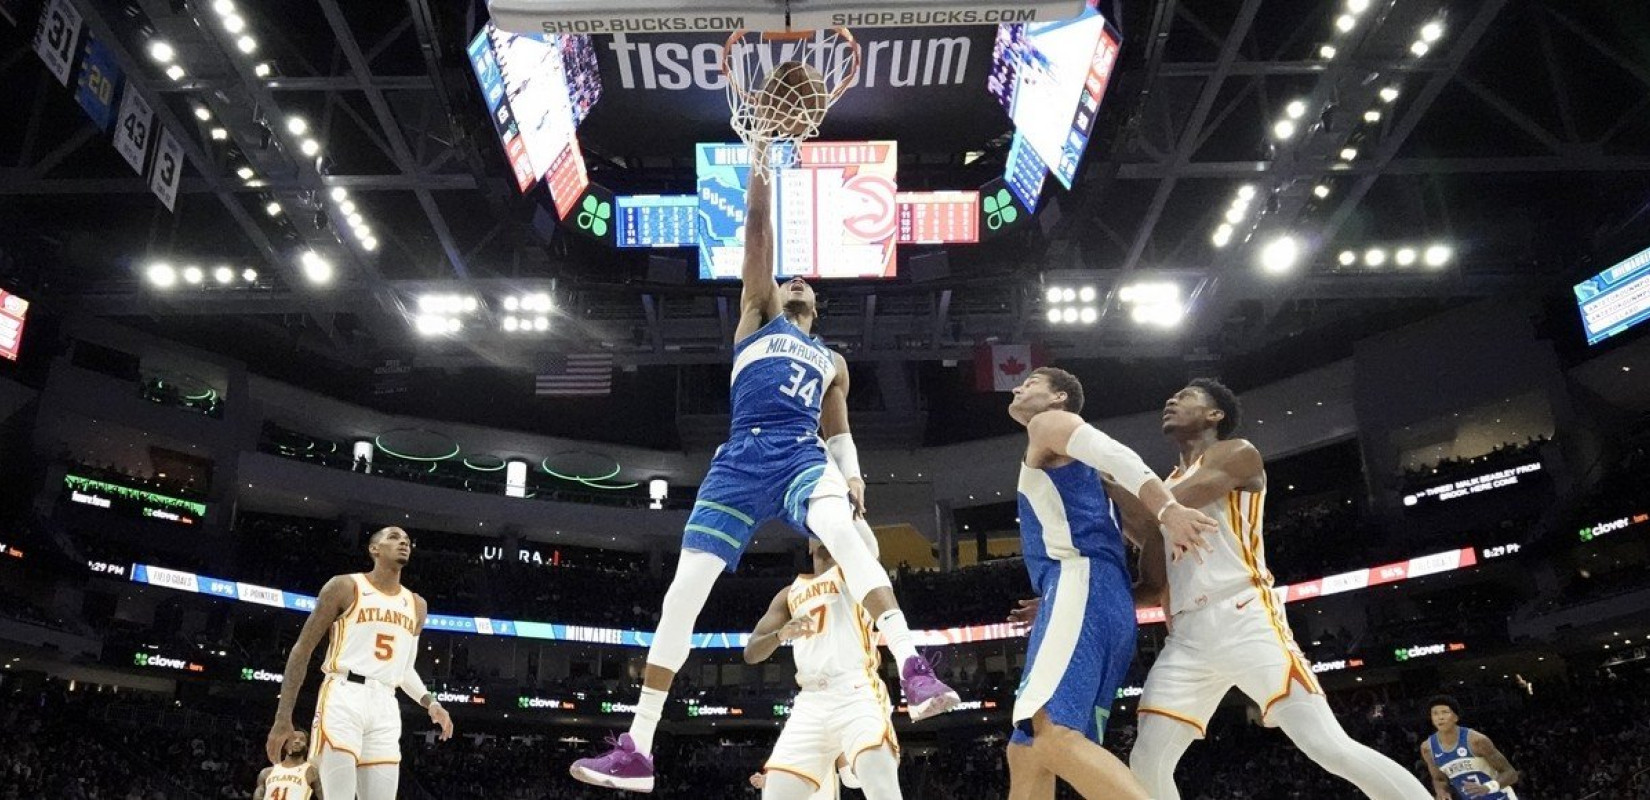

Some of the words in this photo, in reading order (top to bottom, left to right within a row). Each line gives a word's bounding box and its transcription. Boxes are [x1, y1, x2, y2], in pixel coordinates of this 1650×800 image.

[541, 17, 745, 33] SHOP.BUCKS.COM
[832, 8, 1037, 26] SHOP.BUCKS.COM
[48, 10, 74, 64] 31
[89, 64, 111, 106] 20
[124, 112, 144, 150] 43
[811, 146, 877, 163] ATLANTA
[161, 152, 175, 187] 3
[702, 187, 743, 222] BUCKS
[766, 337, 828, 375] MILWAUKEE
[779, 361, 819, 407] 34
[1591, 517, 1629, 536] clover
[107, 564, 124, 575] PM
[356, 607, 414, 635] ATLANTA
[566, 625, 622, 645] MILWAUKEE
[374, 633, 395, 661] 5
[1408, 643, 1446, 658] clover
[148, 655, 187, 670] clover
[1312, 659, 1346, 673] clover
[253, 668, 284, 683] clove
[438, 693, 470, 703] clover
[530, 697, 561, 708] clover
[611, 703, 638, 713] clove
[698, 705, 728, 715] clover
